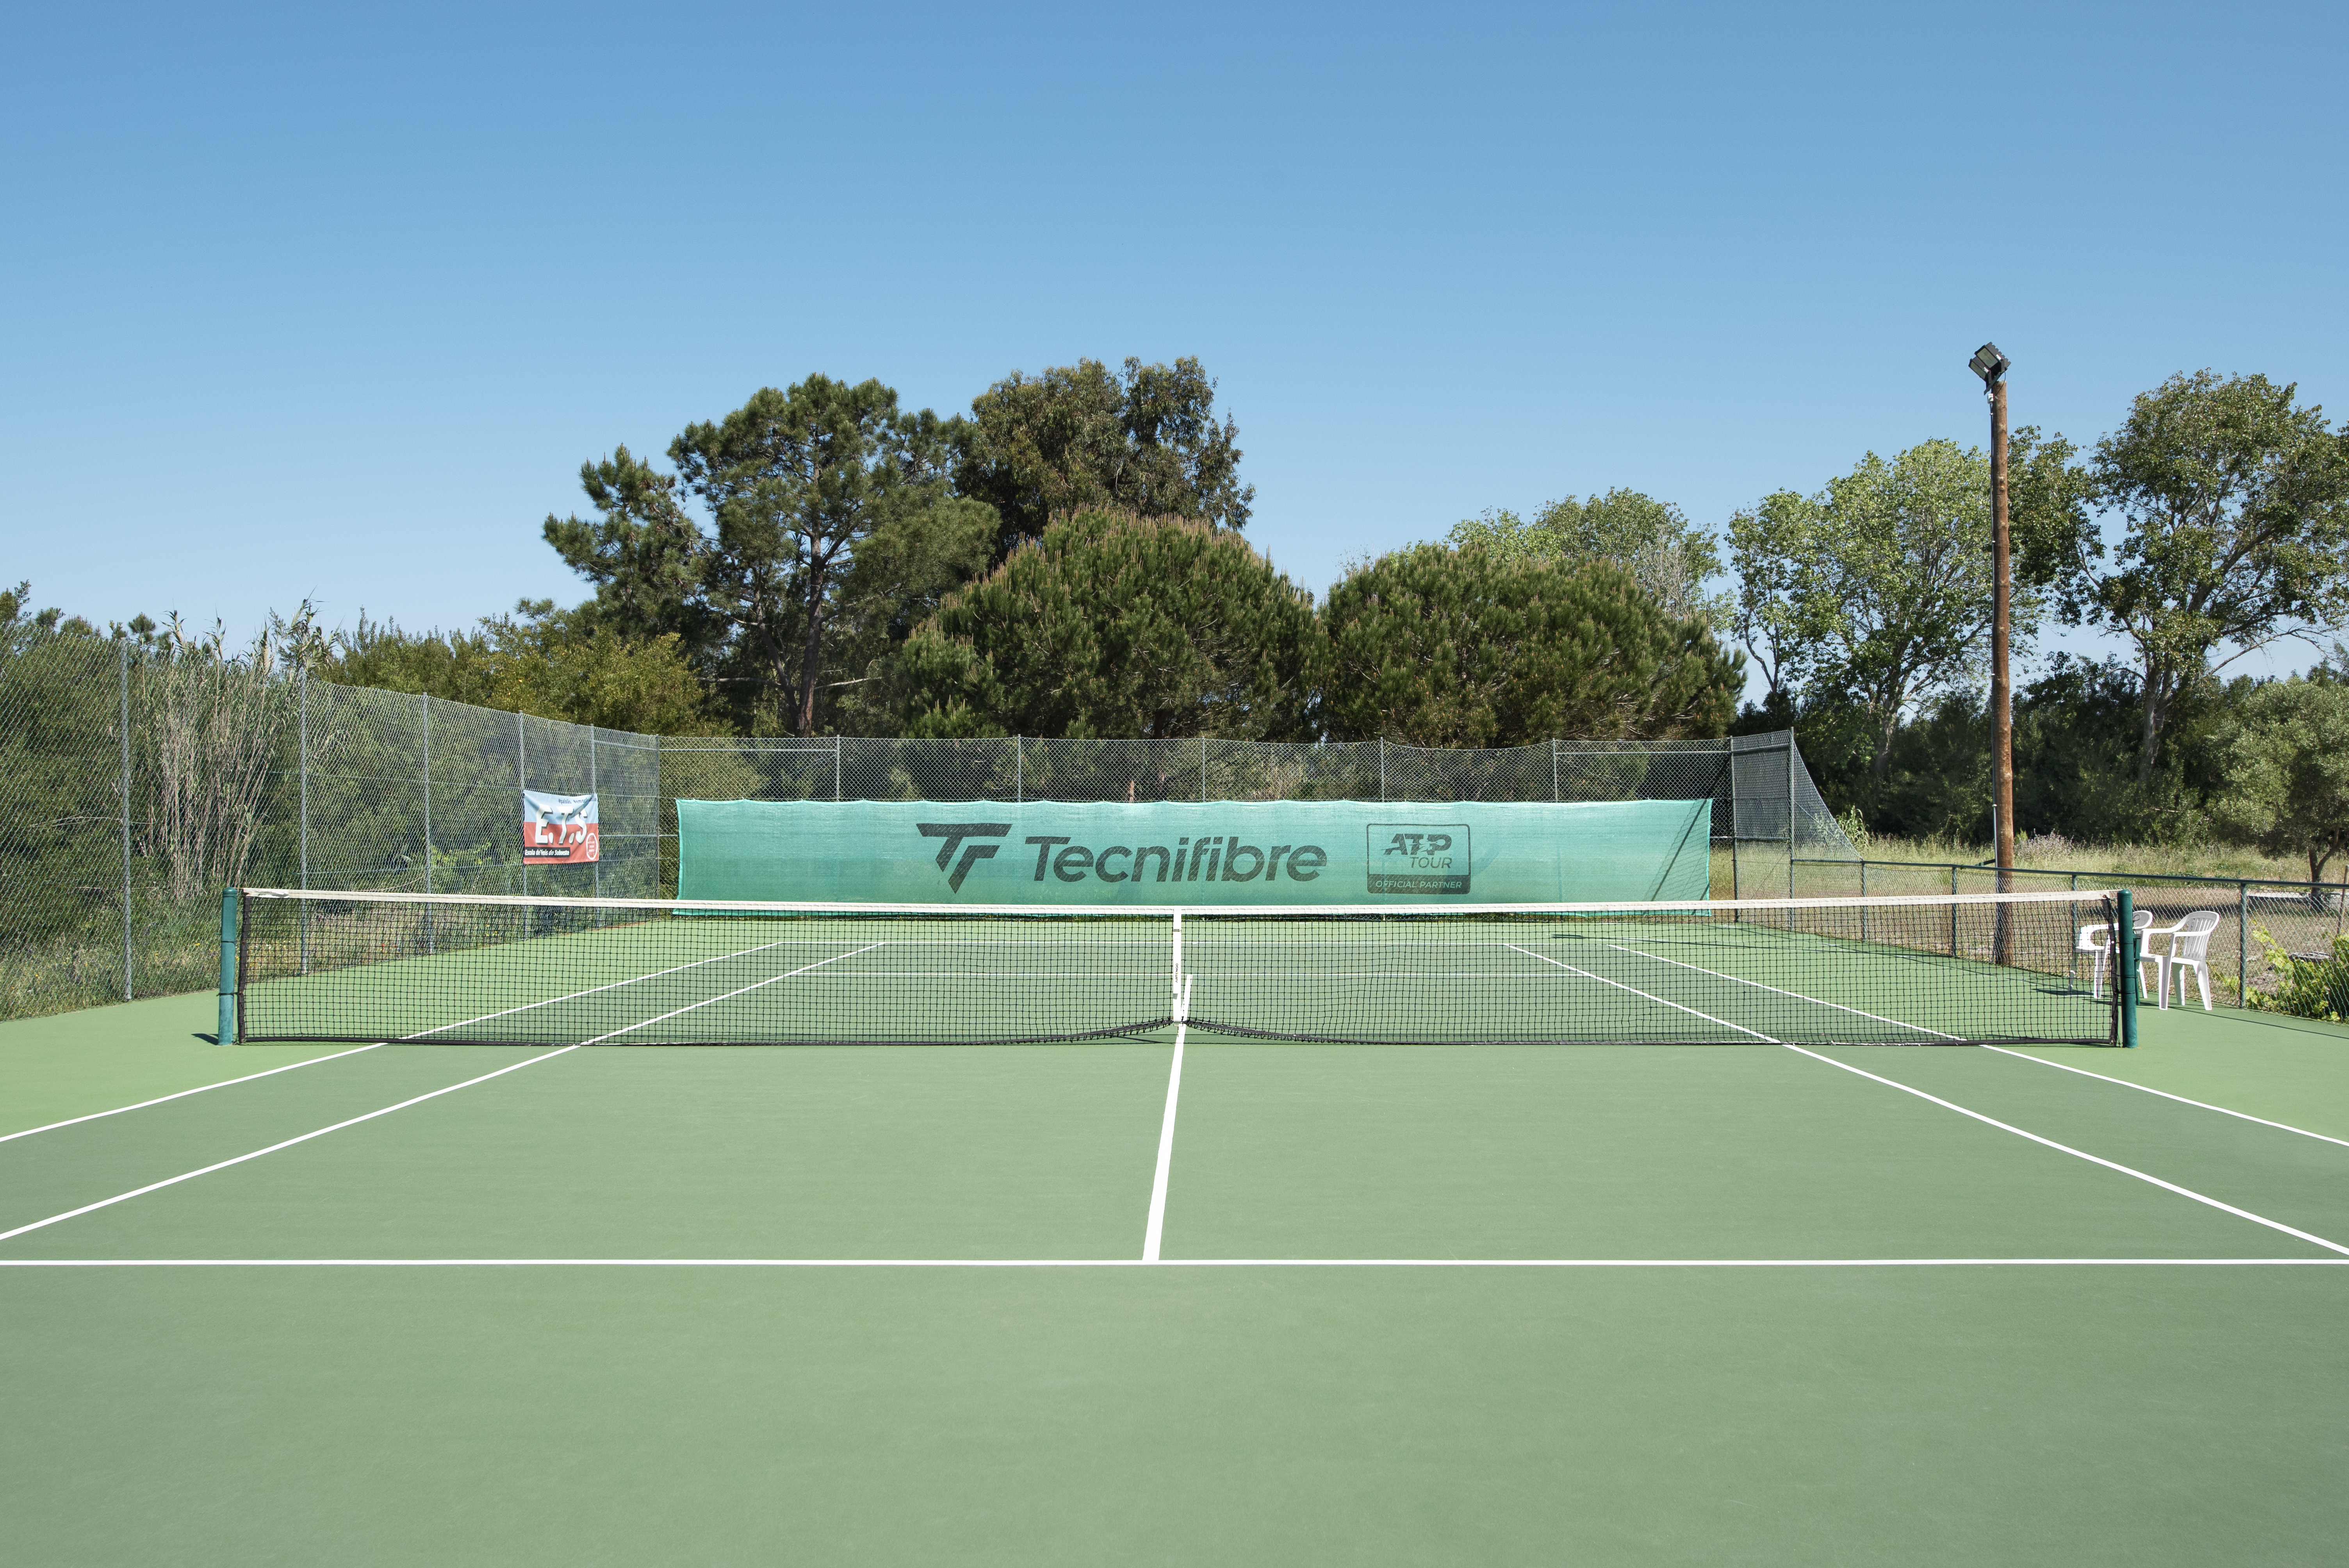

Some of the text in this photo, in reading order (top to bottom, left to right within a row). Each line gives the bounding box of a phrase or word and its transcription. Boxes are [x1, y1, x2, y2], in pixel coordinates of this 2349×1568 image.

[1381, 833, 1452, 855] ATP
[1025, 836, 1327, 882] Tecnifibre
[1410, 857, 1453, 869] TOUR
